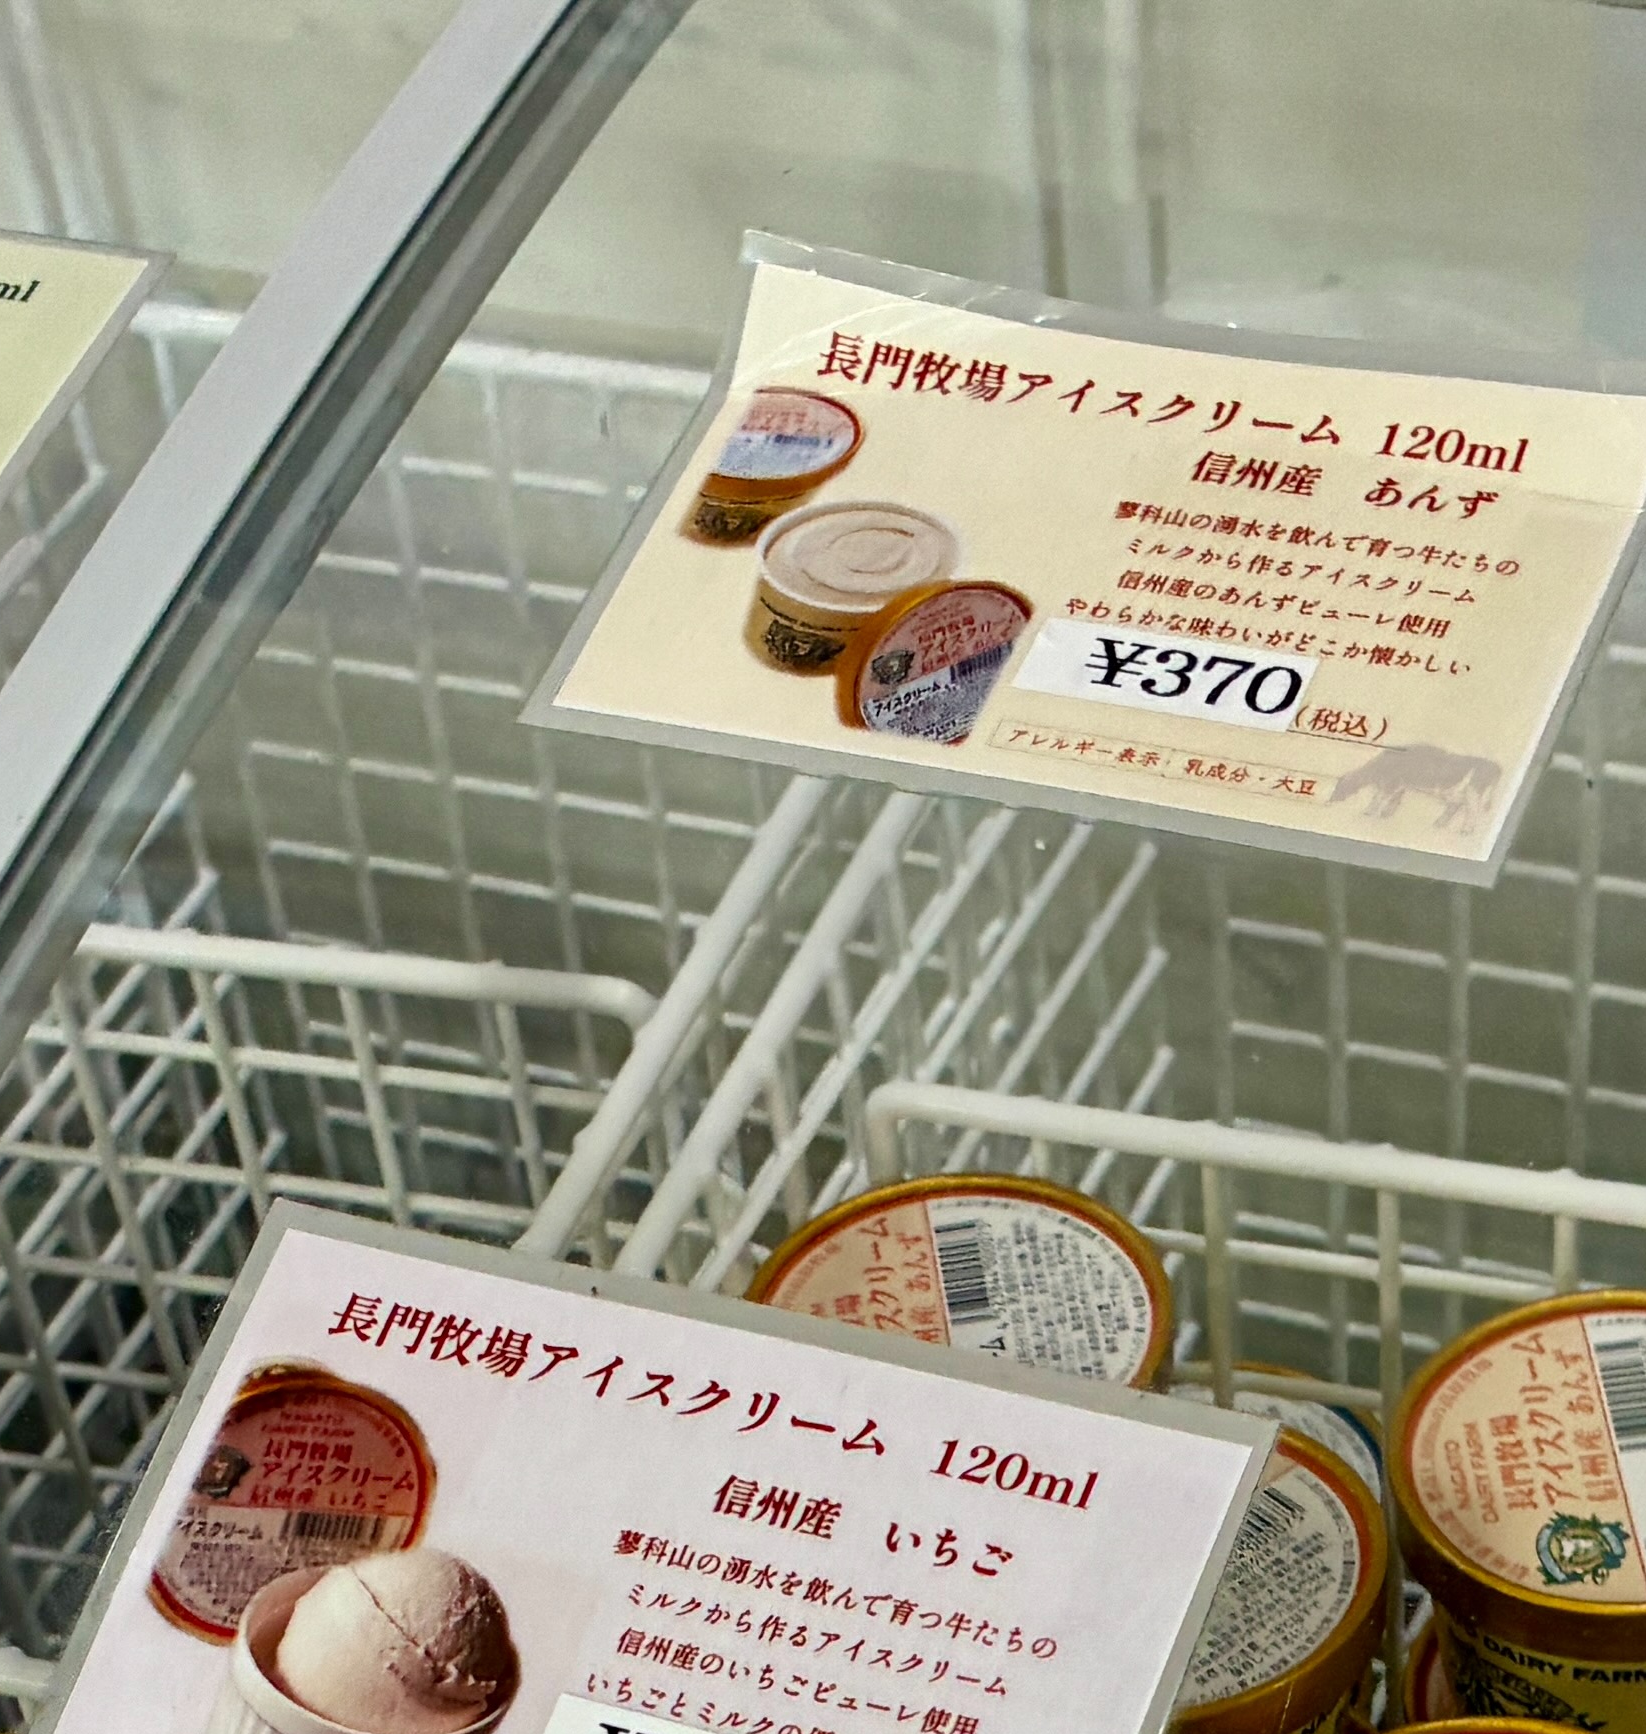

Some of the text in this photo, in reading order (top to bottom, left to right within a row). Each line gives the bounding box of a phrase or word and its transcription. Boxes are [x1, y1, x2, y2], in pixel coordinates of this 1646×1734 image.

[817, 333, 1529, 473] 長門牧場アイスクリーム 120ml
[1191, 451, 1498, 518] 信州産 あんず
[1114, 501, 1520, 577] 蓼科山の湧水を飲んで育つ牛たちの
[1126, 539, 1477, 605] ミルクから作るアイスクリーム
[1065, 600, 1472, 675] やわらかな味わいがどこか懐かしい
[1117, 570, 1451, 638] 信州産のあんずピューレ使用
[1086, 638, 1388, 738] ¥370 （税込）
[327, 1293, 1100, 1511] 長門牧場アイスクリーム 120ml
[1515, 1334, 1576, 1504] アイスクリーム
[713, 1473, 1013, 1578] 信州産 いちご
[613, 1529, 1059, 1661] 蓼科山の湧水を飲んで育つ牛たちの
[626, 1584, 1008, 1695] ミルクから作るアイスクリーム
[1483, 1638, 1564, 1676] DAIRY
